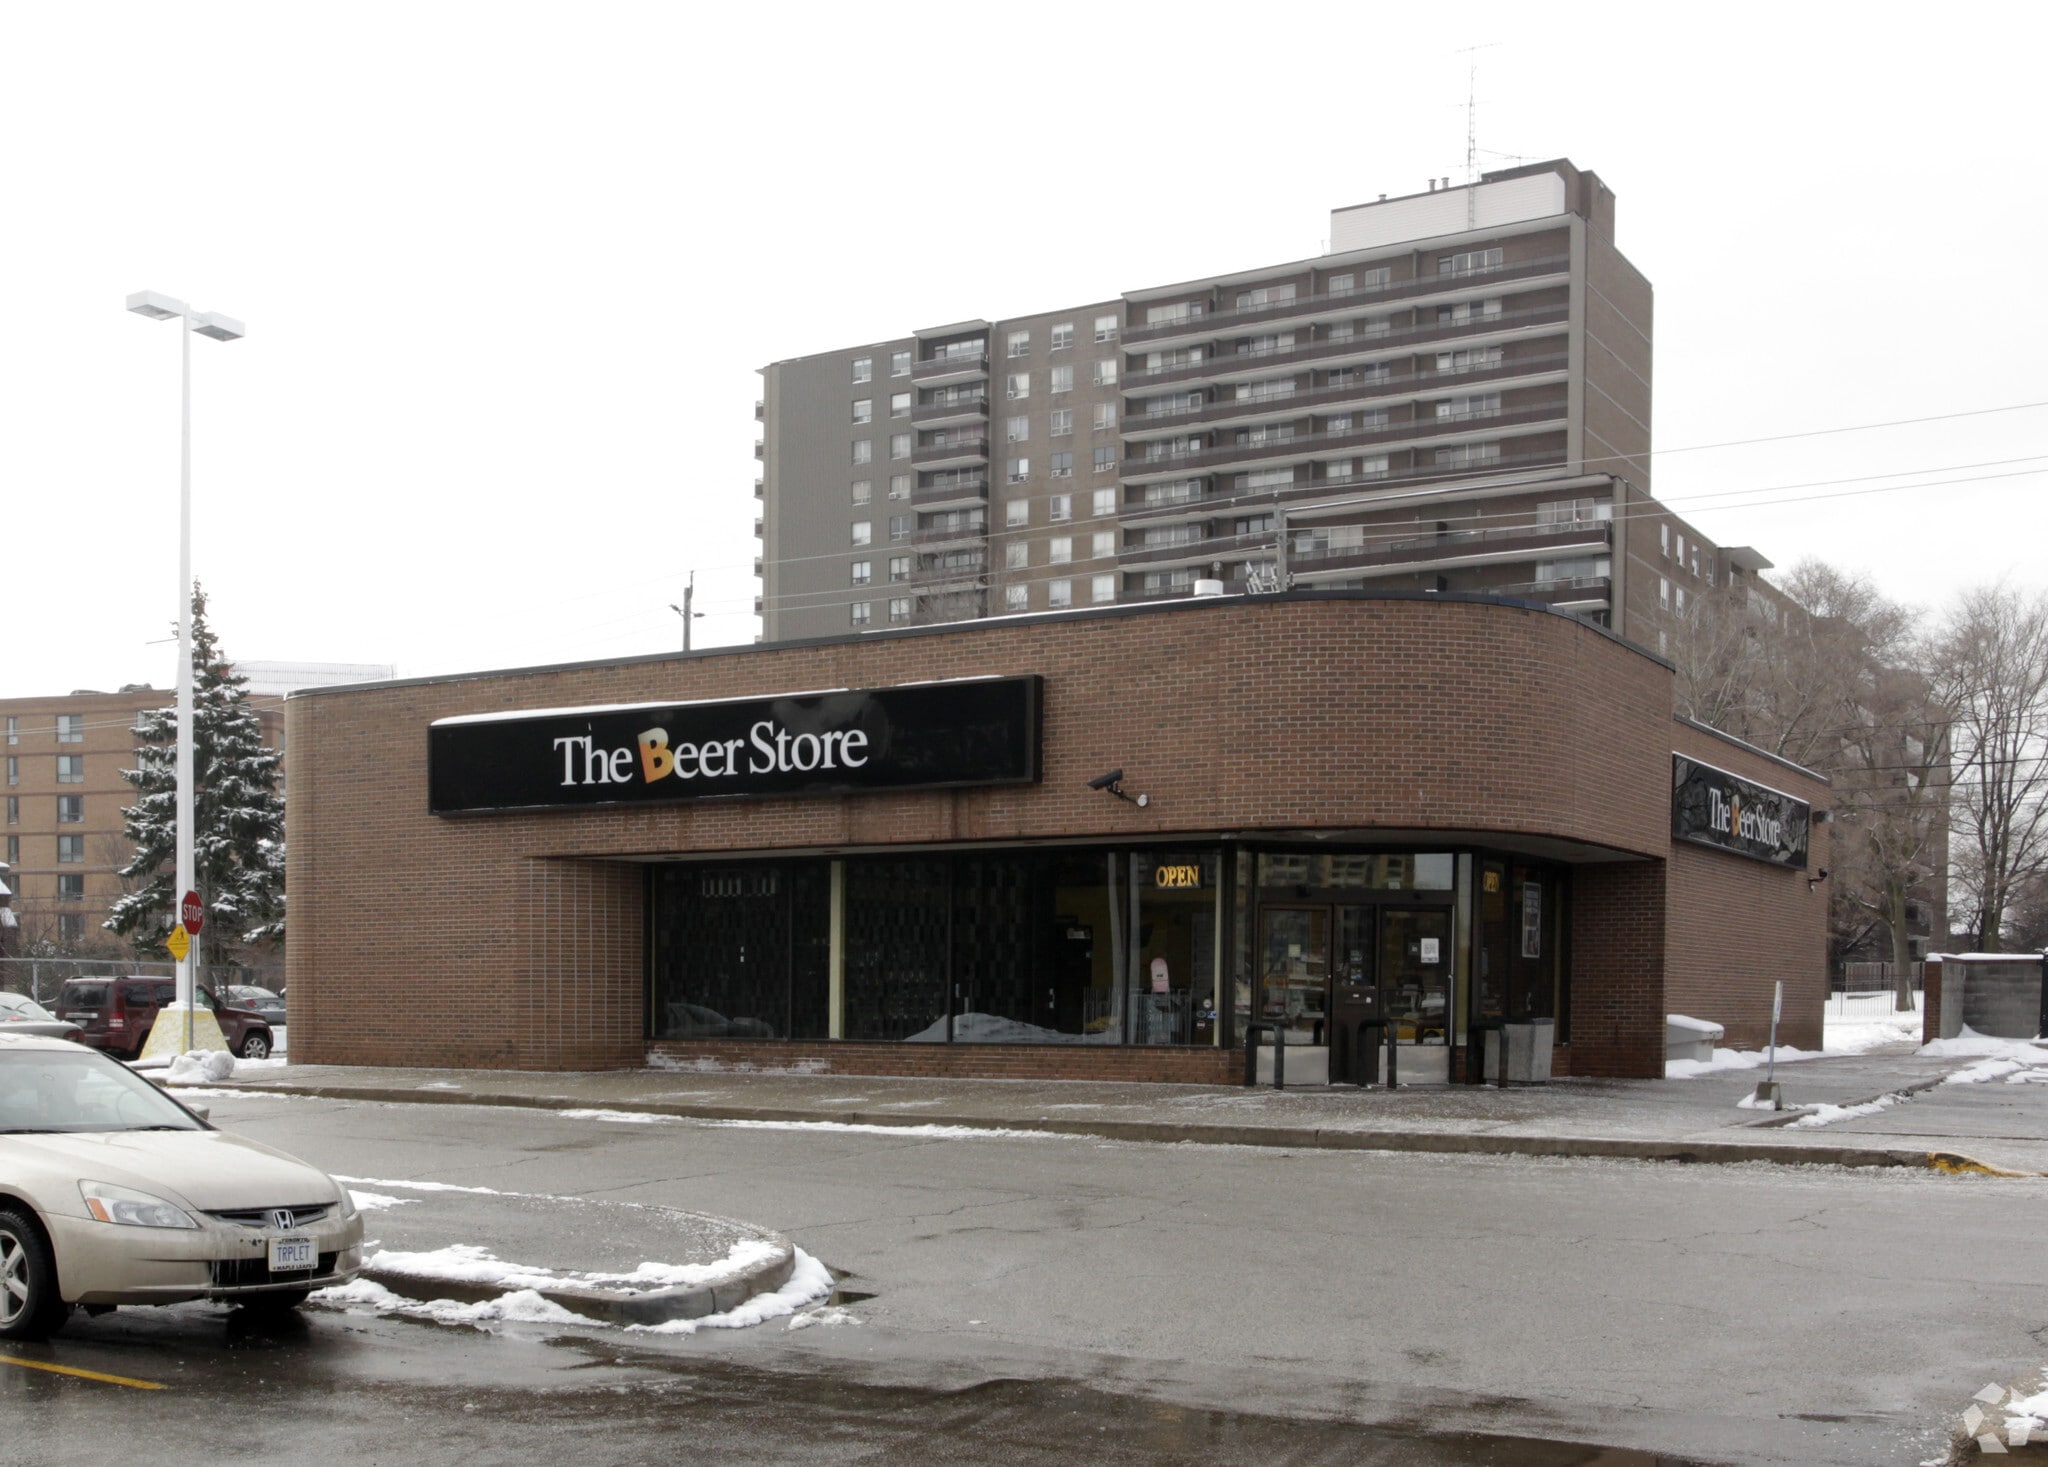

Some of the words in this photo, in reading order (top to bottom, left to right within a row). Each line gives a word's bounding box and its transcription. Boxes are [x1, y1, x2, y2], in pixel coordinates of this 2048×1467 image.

[553, 722, 633, 785] The
[637, 727, 744, 784] Beer
[749, 720, 868, 775] Store
[1709, 787, 1730, 833] The
[1731, 794, 1756, 840] Beer
[1756, 804, 1781, 847] Store
[1156, 864, 1199, 887] OPEN
[183, 903, 203, 922] STOP
[277, 1245, 310, 1262] TRPLET
